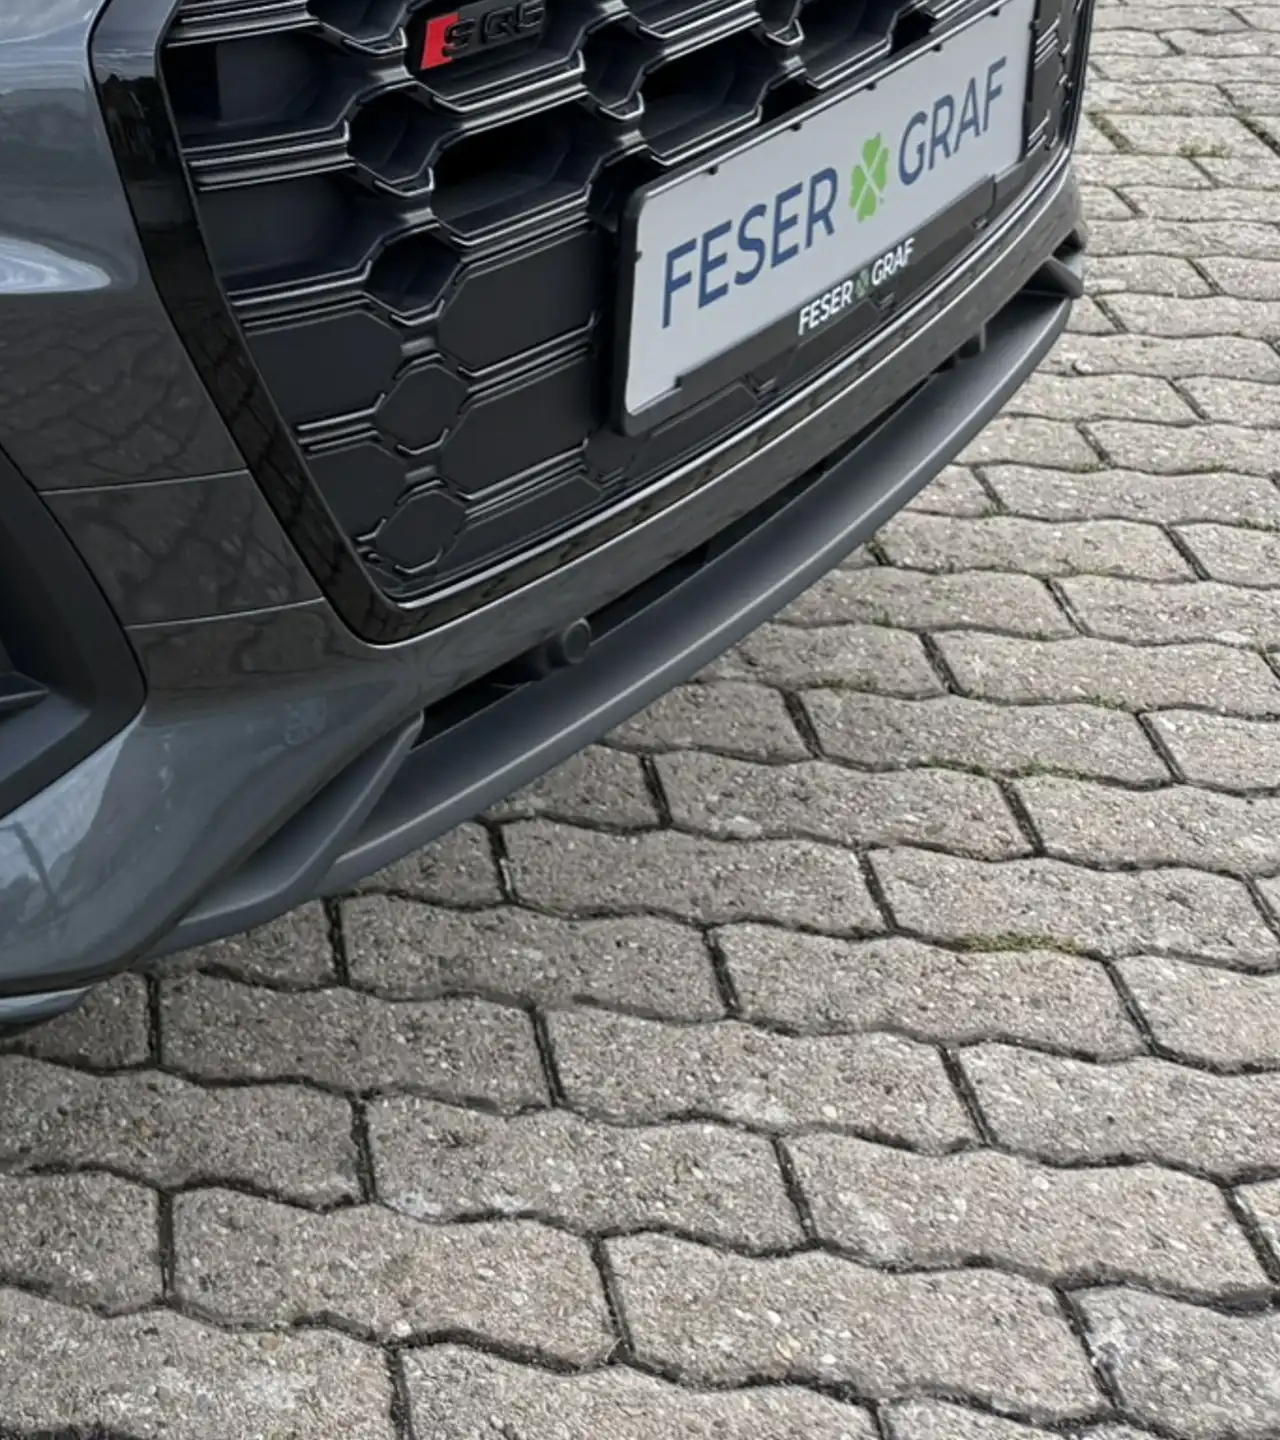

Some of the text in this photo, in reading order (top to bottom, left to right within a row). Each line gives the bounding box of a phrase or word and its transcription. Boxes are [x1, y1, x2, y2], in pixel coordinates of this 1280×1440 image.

[661, 55, 1008, 330] FESER GRAF
[797, 237, 916, 336] FESER GRAF
